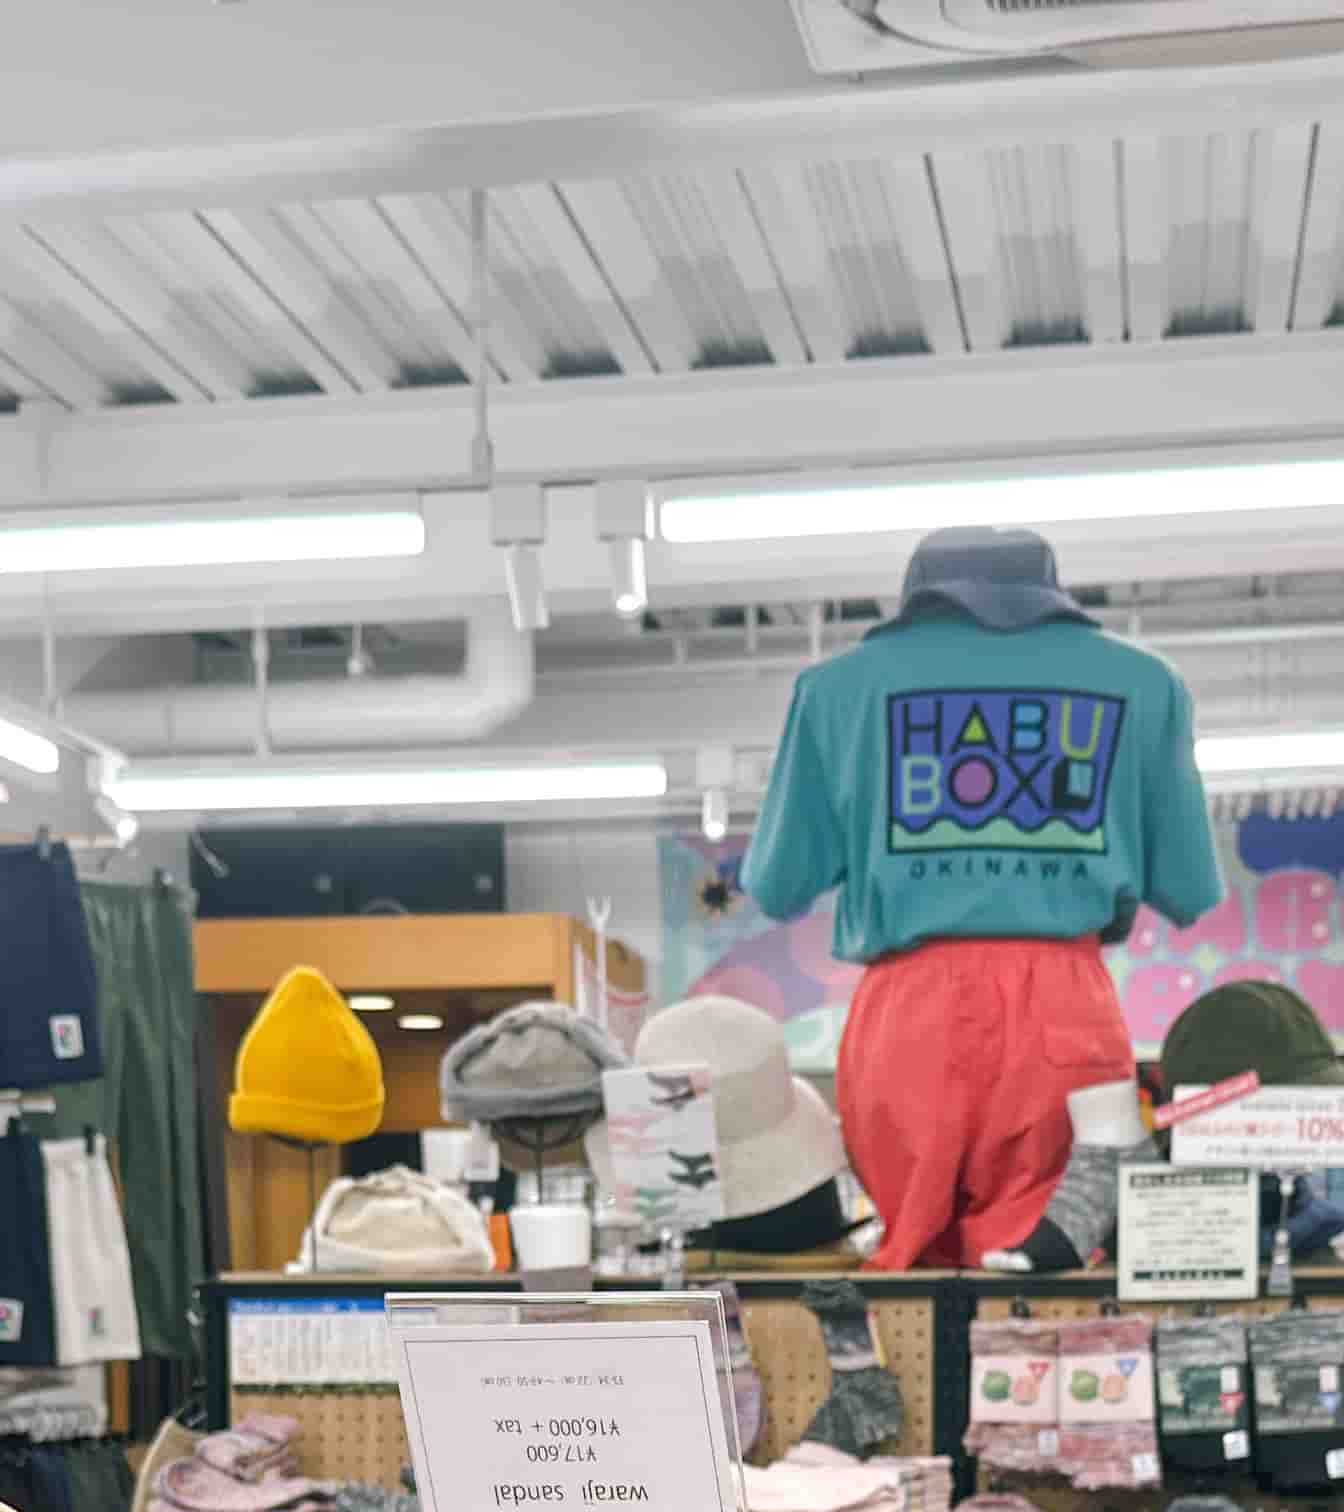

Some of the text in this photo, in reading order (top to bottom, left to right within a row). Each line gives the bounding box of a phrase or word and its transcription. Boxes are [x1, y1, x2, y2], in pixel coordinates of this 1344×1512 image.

[902, 697, 1104, 759] HABU
[901, 754, 1050, 816] BOX
[909, 859, 1089, 881] OKINAWA
[494, 1418, 523, 1434] tax
[526, 1444, 597, 1463] ¥17,600
[494, 1480, 650, 1506] waraji sandal
